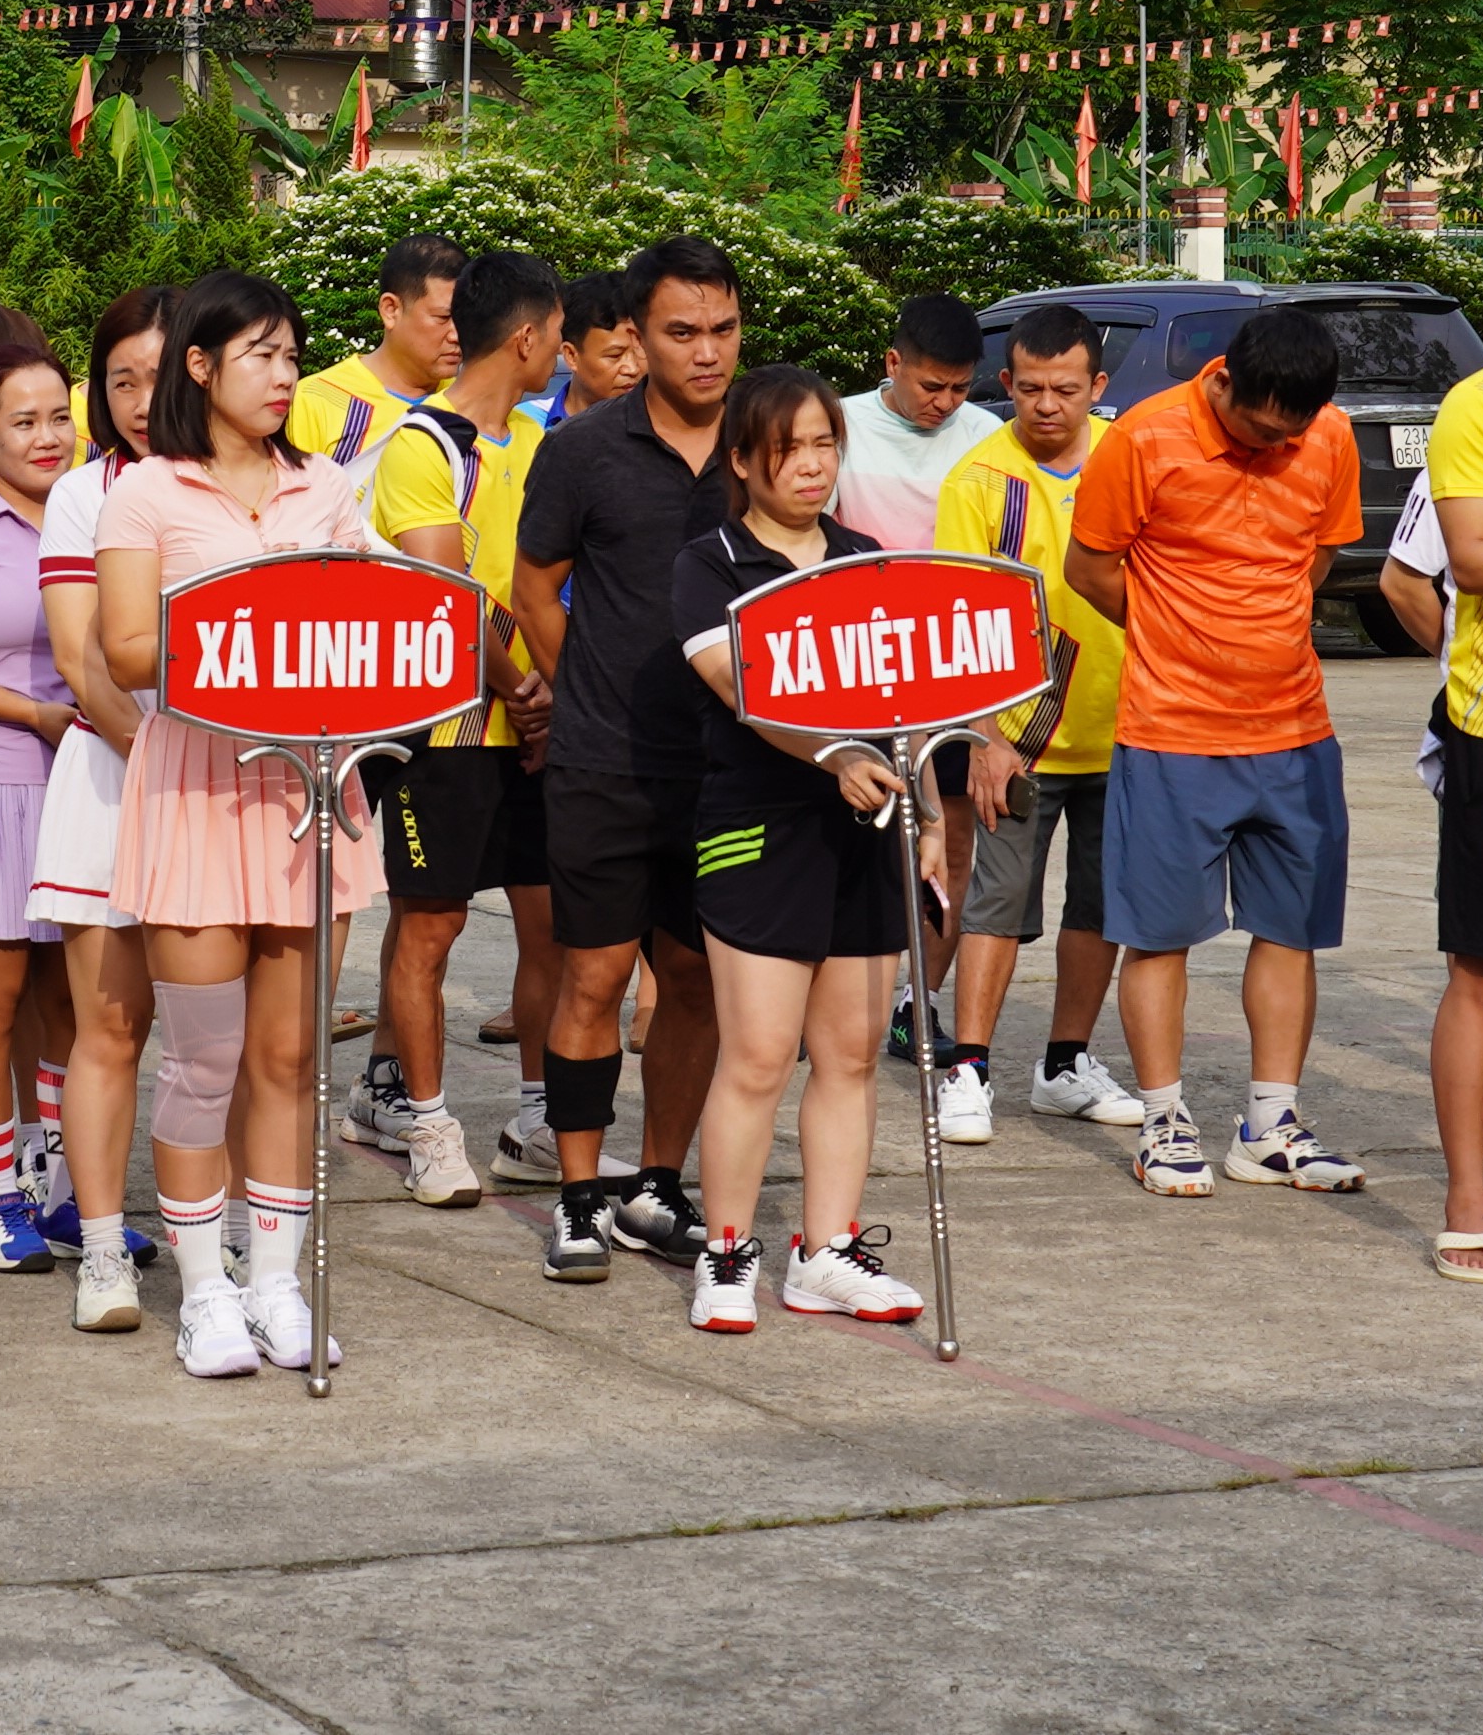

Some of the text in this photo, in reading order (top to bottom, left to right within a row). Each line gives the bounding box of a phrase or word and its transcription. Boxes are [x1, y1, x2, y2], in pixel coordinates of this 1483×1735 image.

[1396, 448, 1429, 465] 050.
[1403, 427, 1429, 446] 23A
[193, 595, 455, 689] XÃ LINH HỒ
[765, 598, 1016, 698] XÃ VIỆT LÂM
